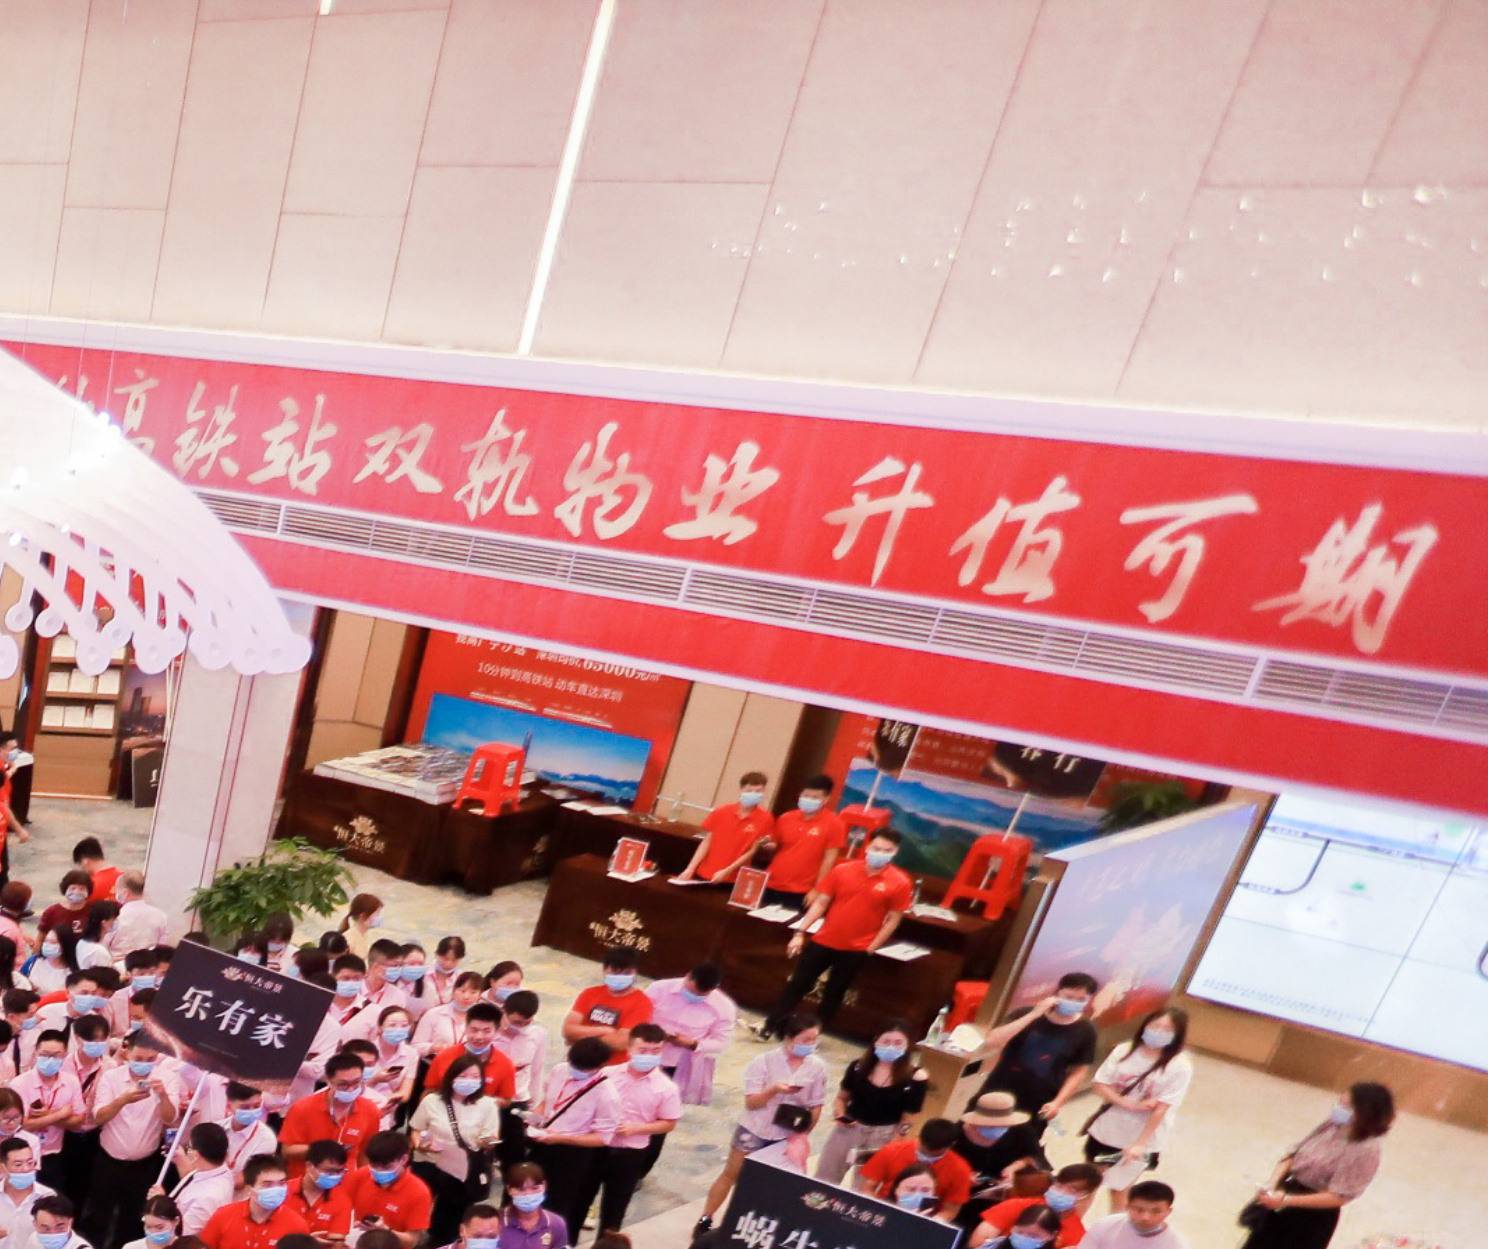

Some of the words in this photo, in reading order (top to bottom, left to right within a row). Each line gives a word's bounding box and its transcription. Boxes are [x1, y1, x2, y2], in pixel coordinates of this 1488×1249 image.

[55, 367, 1439, 656] 高铁站双轨物业升值可期
[174, 985, 295, 1049] 乐有家
